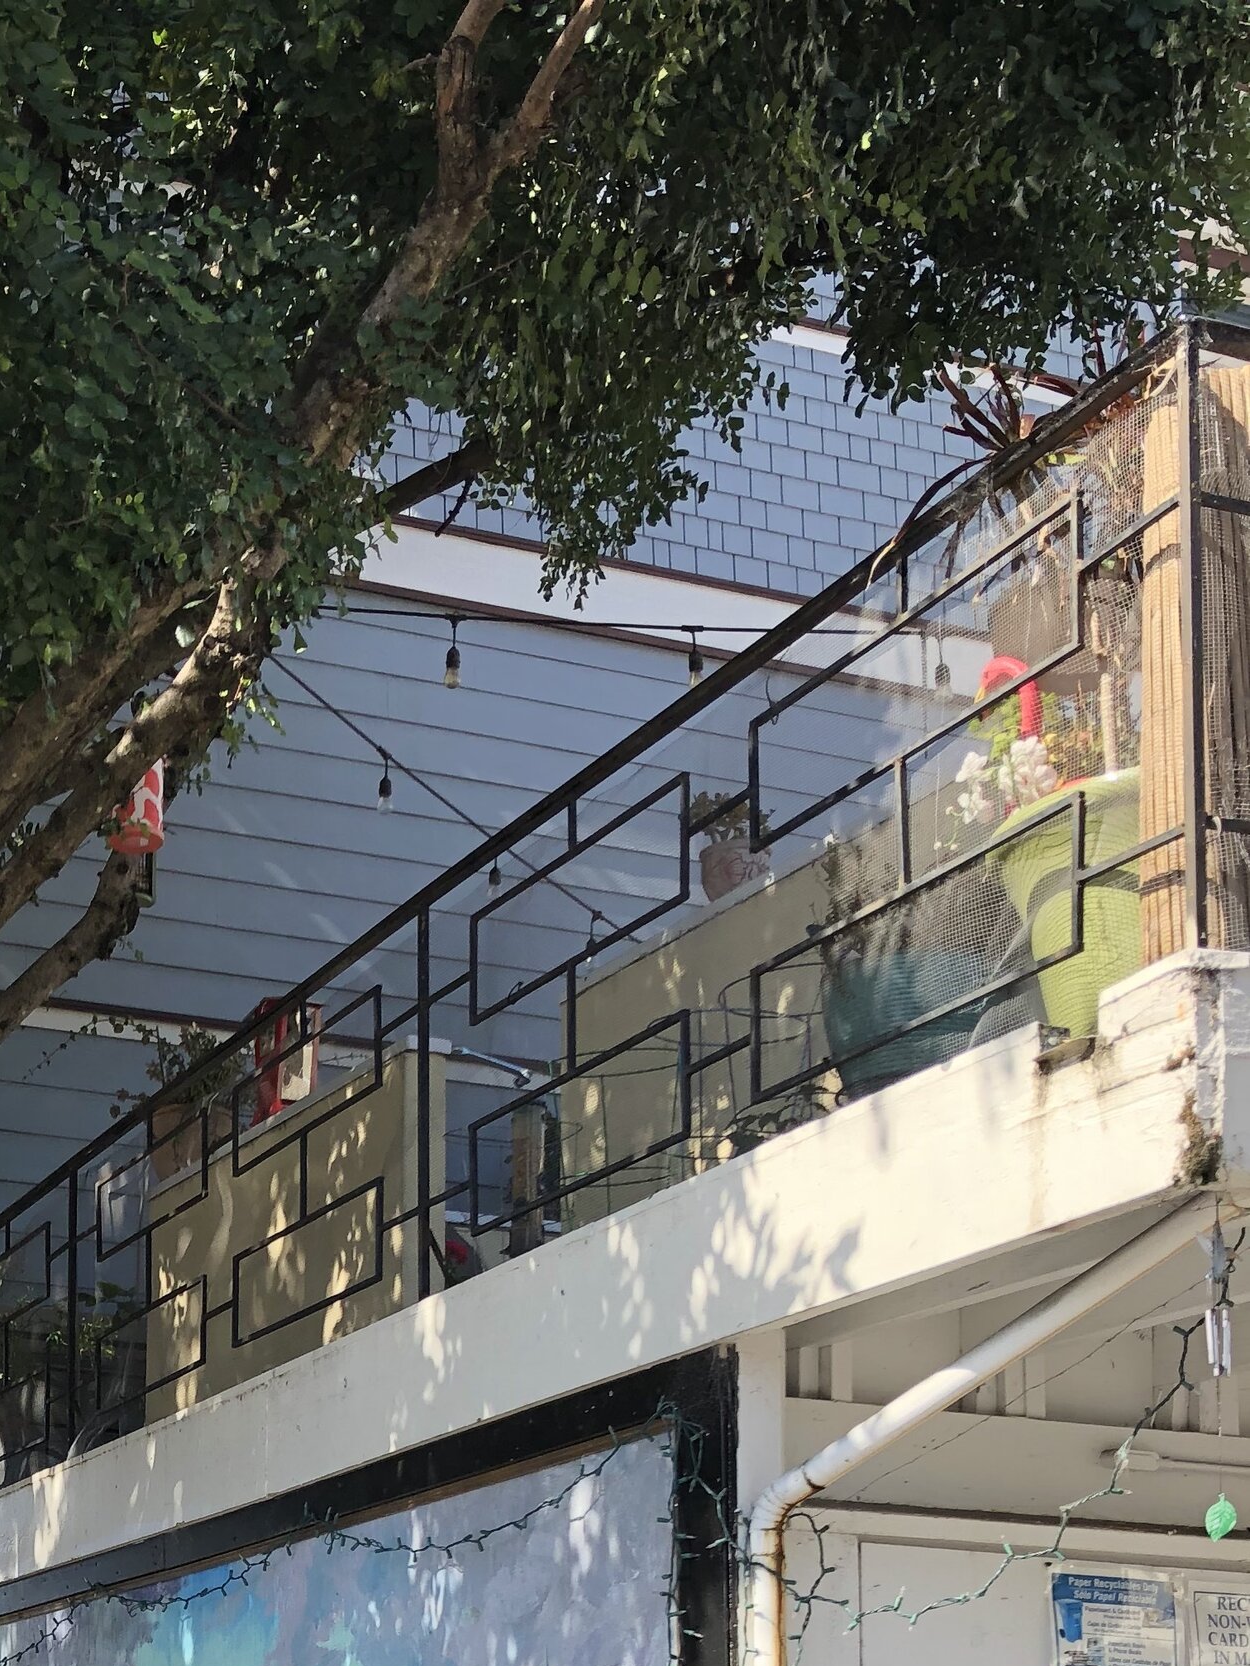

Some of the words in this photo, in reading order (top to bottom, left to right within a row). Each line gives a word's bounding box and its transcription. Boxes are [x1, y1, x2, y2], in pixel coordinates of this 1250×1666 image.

[1069, 1577, 1092, 1588] Paper
[1094, 1578, 1141, 1590] Recyclables
[1143, 1583, 1158, 1594] Only
[1093, 1591, 1116, 1602] Papel
[1218, 1597, 1250, 1611] REC
[1214, 1650, 1230, 1664] IN
[1235, 1652, 1250, 1666] M
